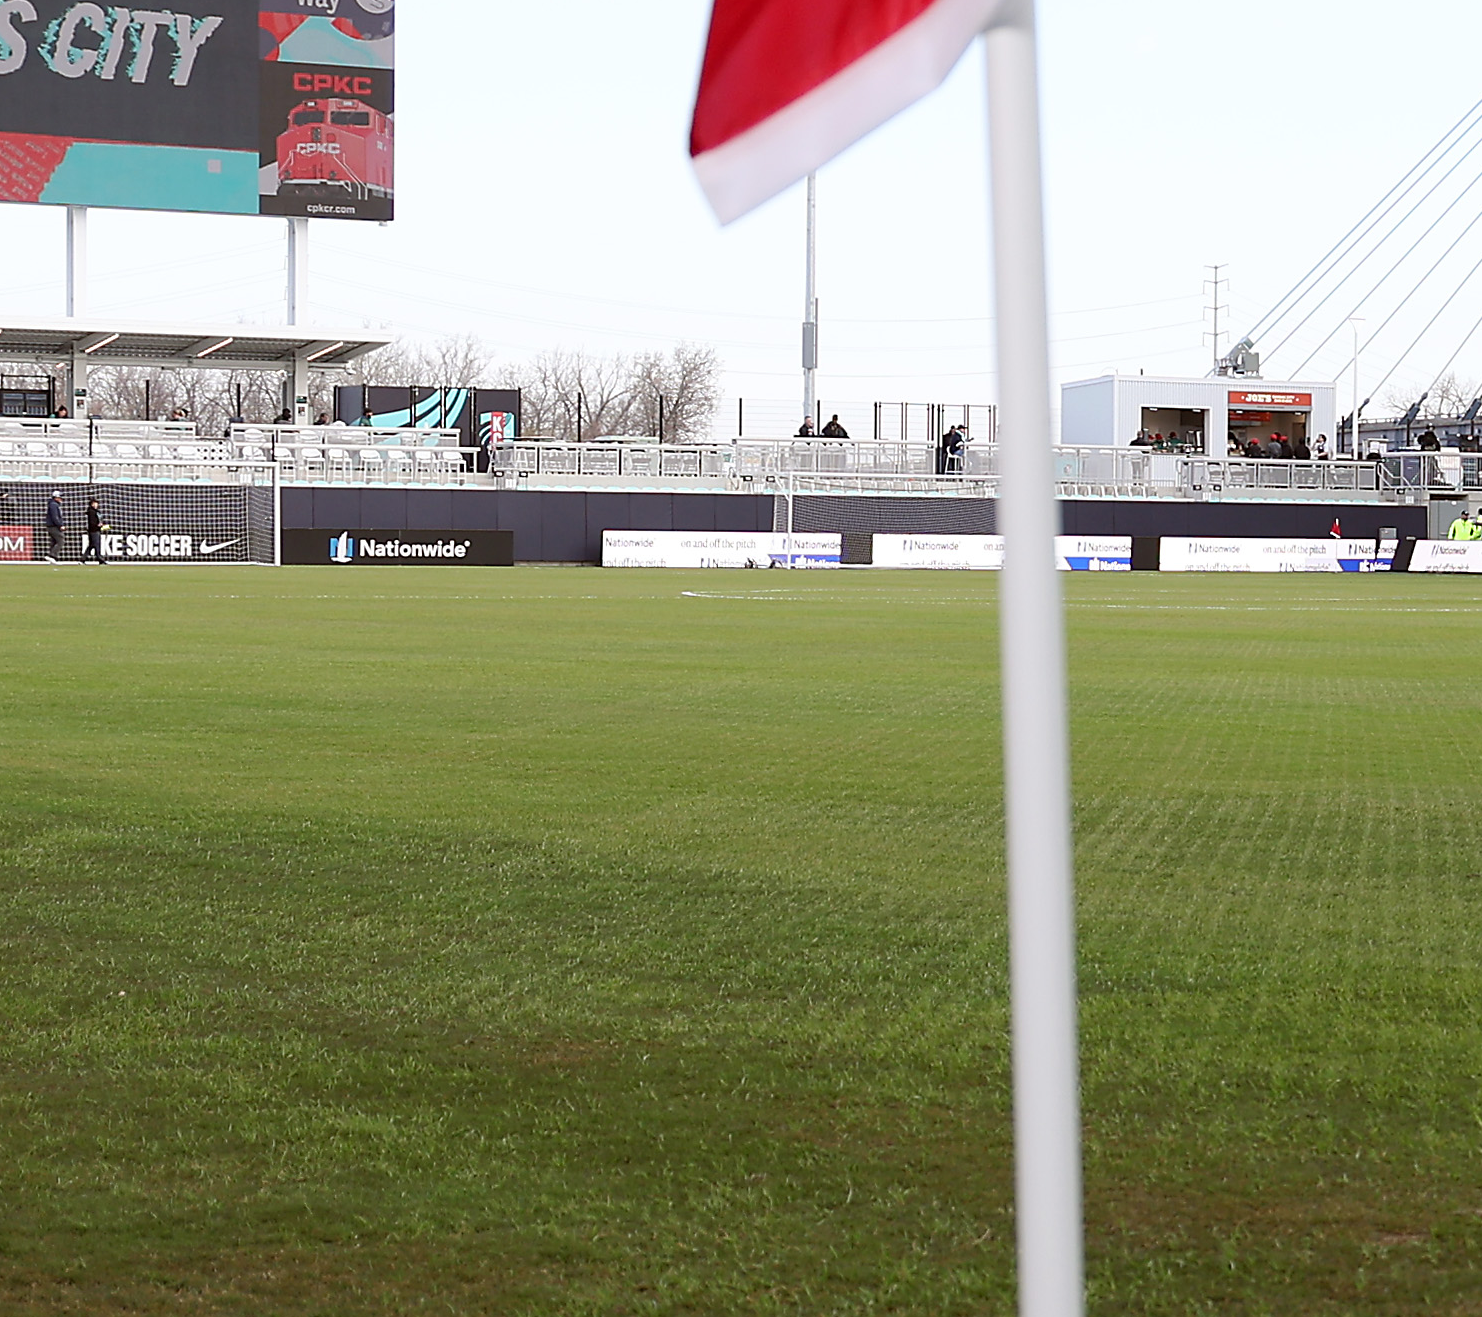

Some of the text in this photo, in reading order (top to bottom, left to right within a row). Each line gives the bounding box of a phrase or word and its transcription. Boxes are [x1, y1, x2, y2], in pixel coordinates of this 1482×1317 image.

[38, 2, 224, 87] CITY
[293, 72, 373, 95] CPKC
[296, 143, 340, 155] CPKC
[306, 203, 356, 214] cpkcr.com
[81, 534, 193, 556] NKE SOCCER
[360, 538, 464, 559] Nationwide
[606, 538, 654, 547] Nationwide
[914, 541, 959, 550] Nationwide
